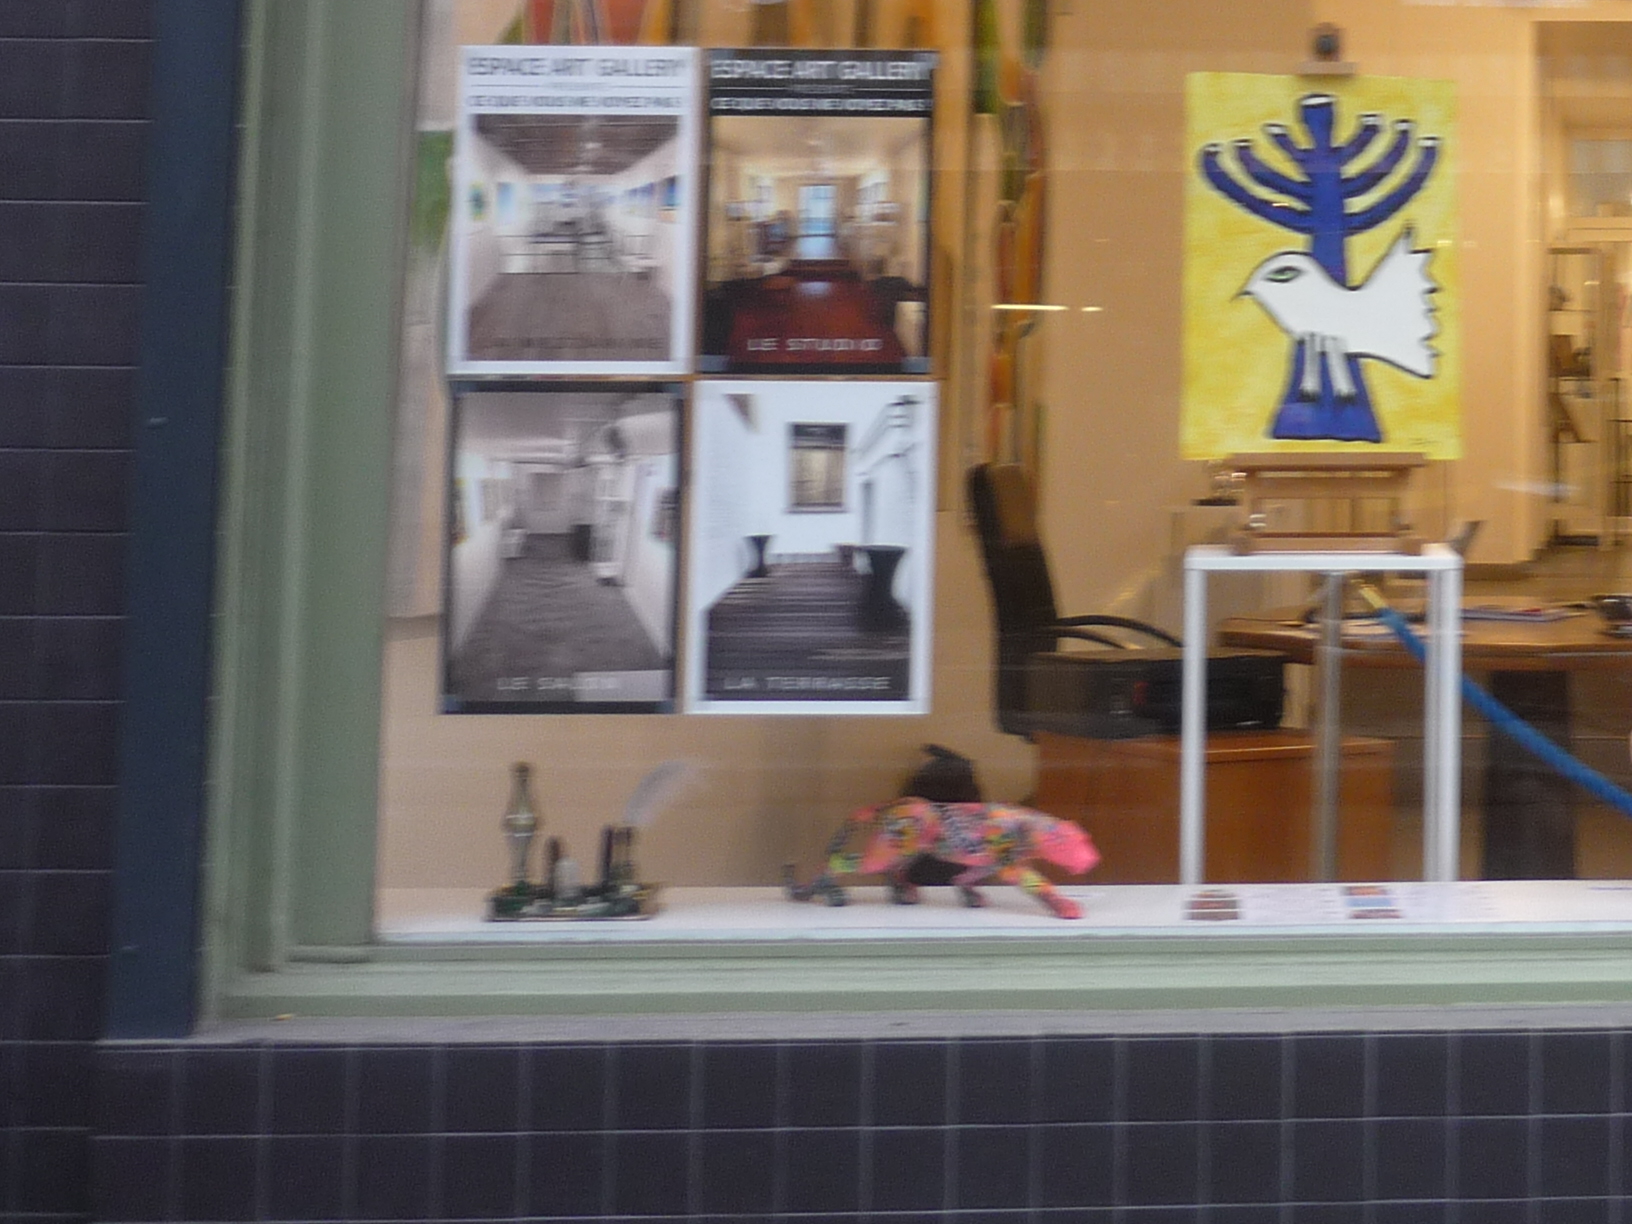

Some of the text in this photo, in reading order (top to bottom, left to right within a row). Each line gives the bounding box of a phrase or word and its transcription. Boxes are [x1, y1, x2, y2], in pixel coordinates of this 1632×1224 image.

[468, 57, 685, 77] ESPACE ART GALLERY
[711, 60, 926, 79] ESPACE ART GALLERY
[765, 676, 891, 690] TERRASSE
